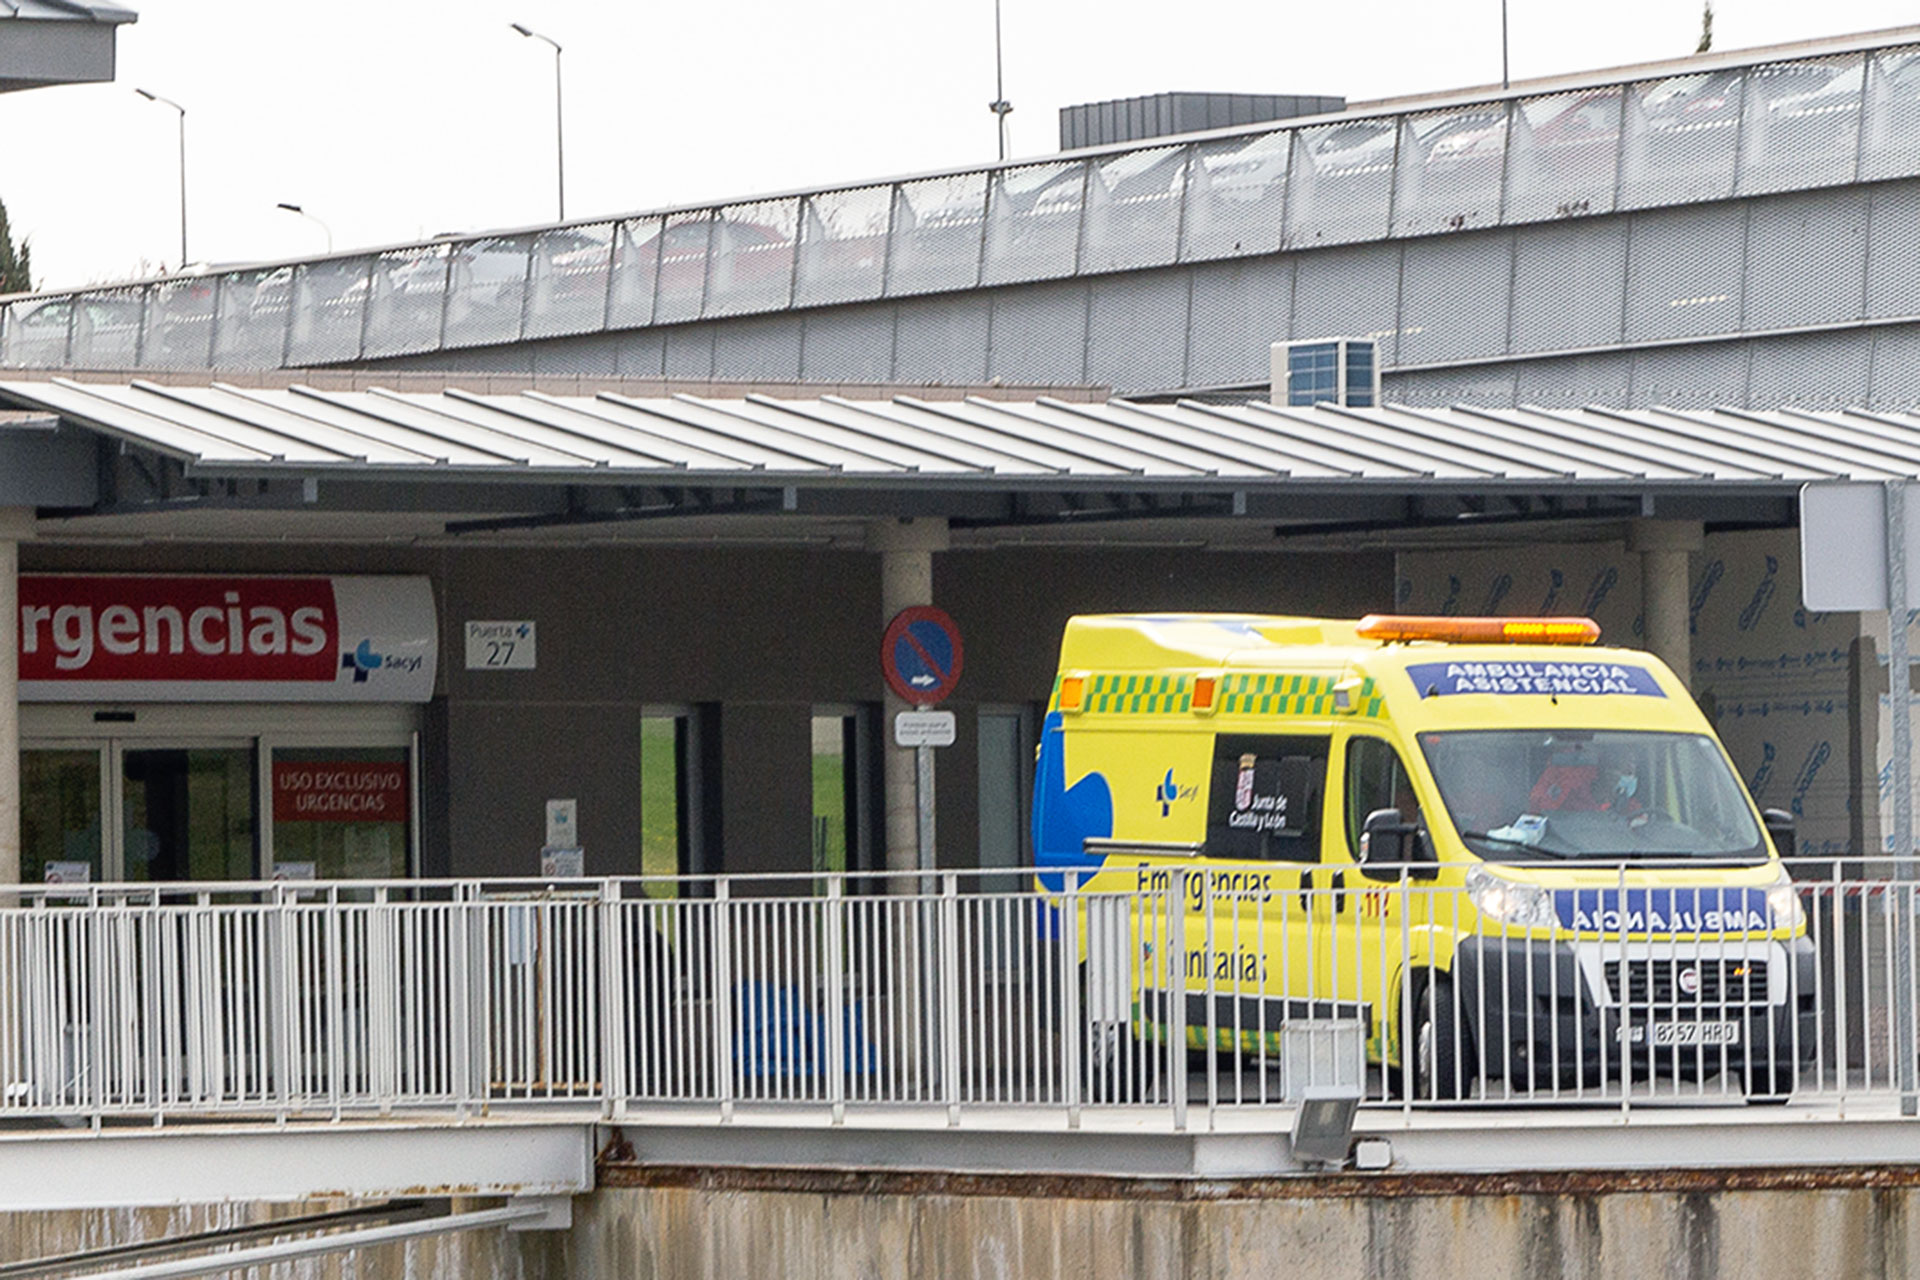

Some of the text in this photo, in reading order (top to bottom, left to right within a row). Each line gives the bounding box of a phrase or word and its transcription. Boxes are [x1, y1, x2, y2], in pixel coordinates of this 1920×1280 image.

[20, 591, 328, 670] rgencias
[470, 624, 512, 638] Puerta
[385, 654, 423, 672] Sacyl
[487, 641, 515, 666] 27
[1447, 663, 1630, 680] AMBULANCIA
[1455, 677, 1638, 693] ASISTENCIAL
[279, 771, 401, 790] USO EXCLUSIVO
[295, 792, 386, 812] URGENCIAS
[1137, 862, 1272, 911] Emrgncias
